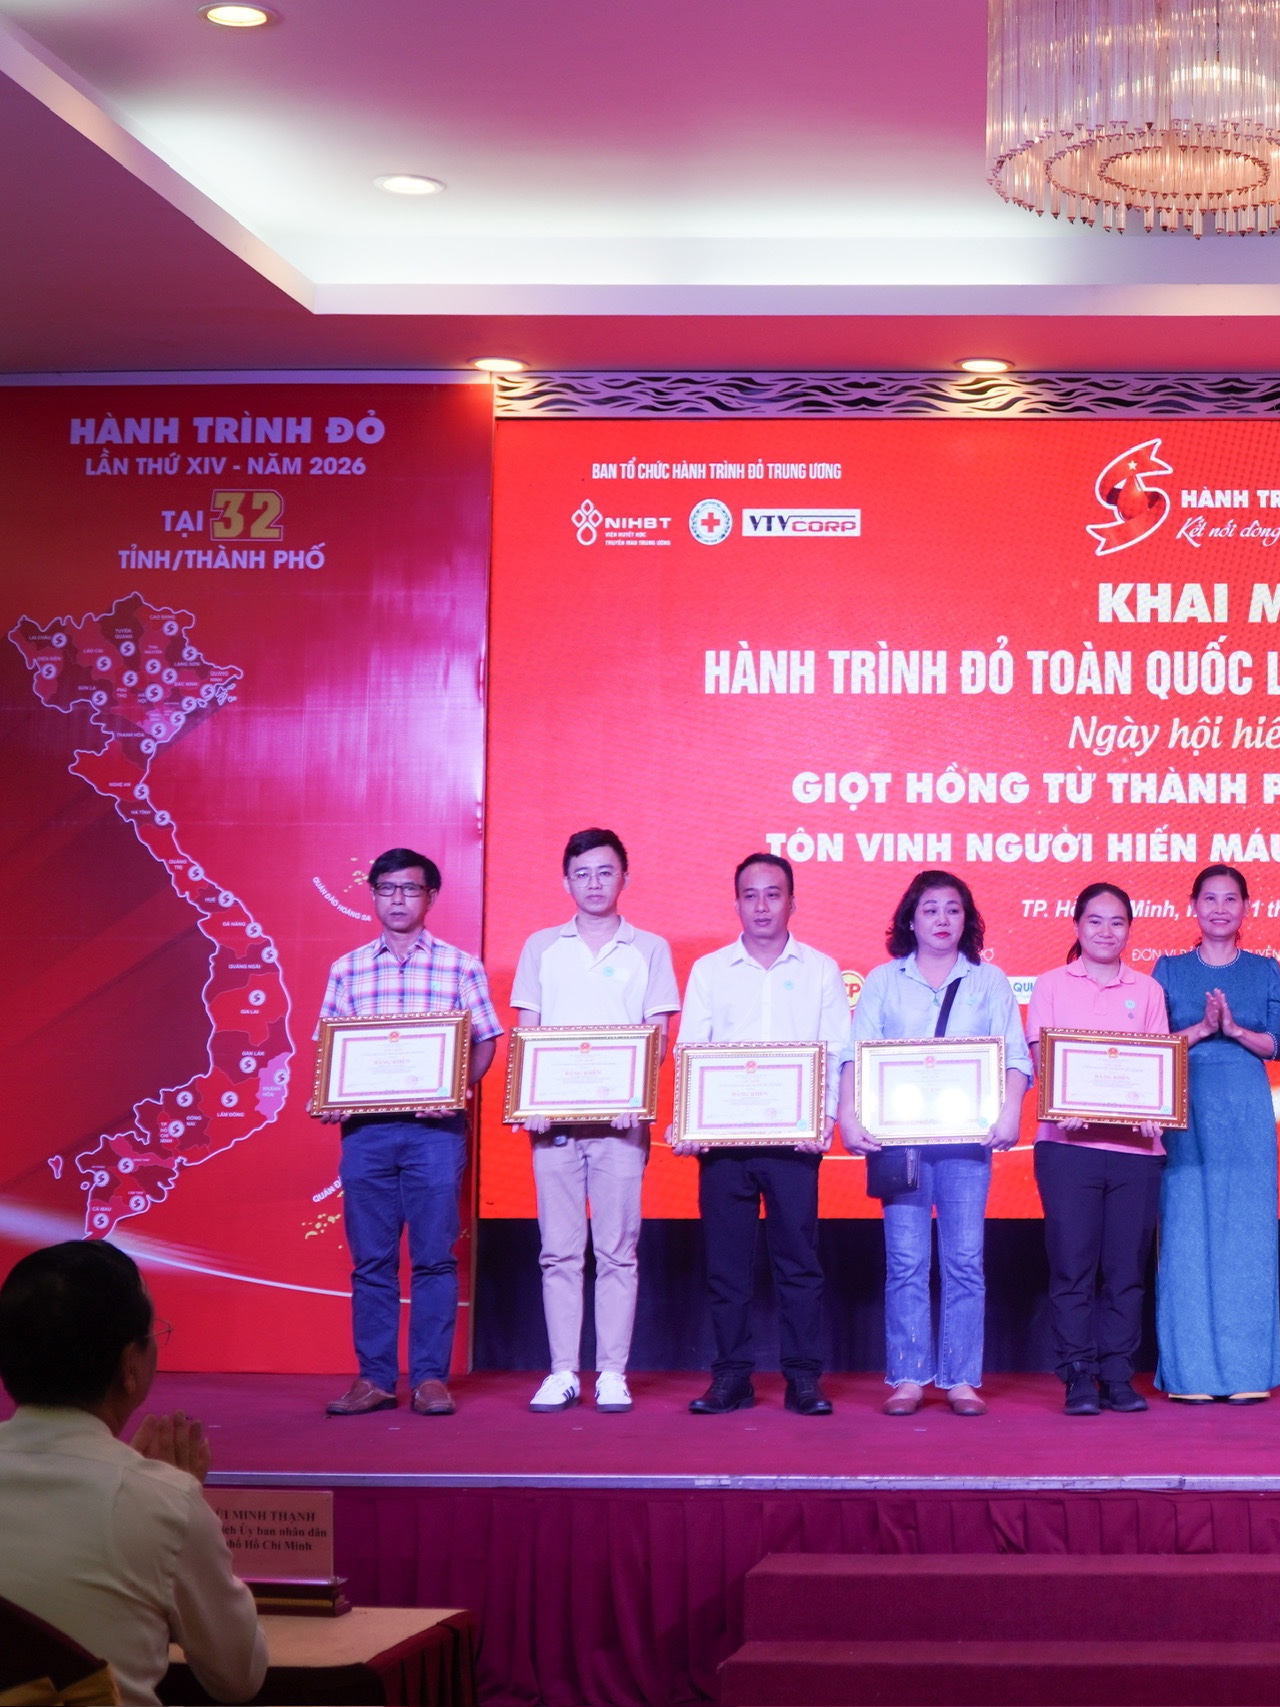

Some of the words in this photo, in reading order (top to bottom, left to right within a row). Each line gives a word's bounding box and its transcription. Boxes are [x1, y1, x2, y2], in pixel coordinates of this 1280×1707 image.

[70, 412, 179, 444] HÀNH
[193, 411, 312, 444] TRÌNH
[325, 409, 385, 444] ĐỎ
[85, 447, 129, 475] LẦN
[136, 452, 181, 475] THỨ
[186, 456, 226, 475] XIV
[247, 452, 302, 475] NĂM
[309, 456, 366, 475] 2026
[592, 463, 617, 480] BAN
[620, 456, 636, 480] TỔ
[638, 460, 669, 480] CHỨC
[672, 460, 706, 480] HÀNH
[709, 460, 745, 480] TRÌNH
[748, 458, 764, 480] ĐỎ
[767, 462, 806, 480] TRUNG
[809, 462, 842, 480] ƯƠNG
[1181, 486, 1249, 509] HÀNH
[162, 510, 203, 538] TẠI
[211, 490, 283, 540] 32
[605, 517, 671, 529] NIHBT
[1176, 515, 1207, 548] Kết
[1209, 519, 1237, 538] nối
[1240, 519, 1280, 547] dòng
[118, 543, 266, 570] TỈNH/THÀNH
[273, 542, 326, 570] PHỐ
[1098, 582, 1229, 623] KHAI
[704, 640, 816, 695] HÀNH
[828, 640, 947, 695] TRÌNH
[959, 635, 1014, 695] ĐỎ
[1026, 641, 1132, 696] TOÀN
[1146, 634, 1253, 700] QUỐC
[1068, 715, 1161, 757] Ngày
[1168, 715, 1224, 757] hội
[791, 771, 892, 812] GIỌT
[906, 761, 1030, 804] HỒNG
[1043, 765, 1097, 804] TỪ
[1107, 767, 1247, 805] THÀNH
[766, 827, 844, 863] TÔN
[856, 833, 952, 863] VINH
[966, 824, 1093, 863] NGƯỜI
[1107, 824, 1197, 863] HIẾN
[1021, 899, 1048, 918] TP.
[232, 1510, 267, 1521] MINH
[270, 1511, 316, 1523] THẠNH
[256, 1526, 275, 1536] ban
[285, 1540, 312, 1551] Minh
